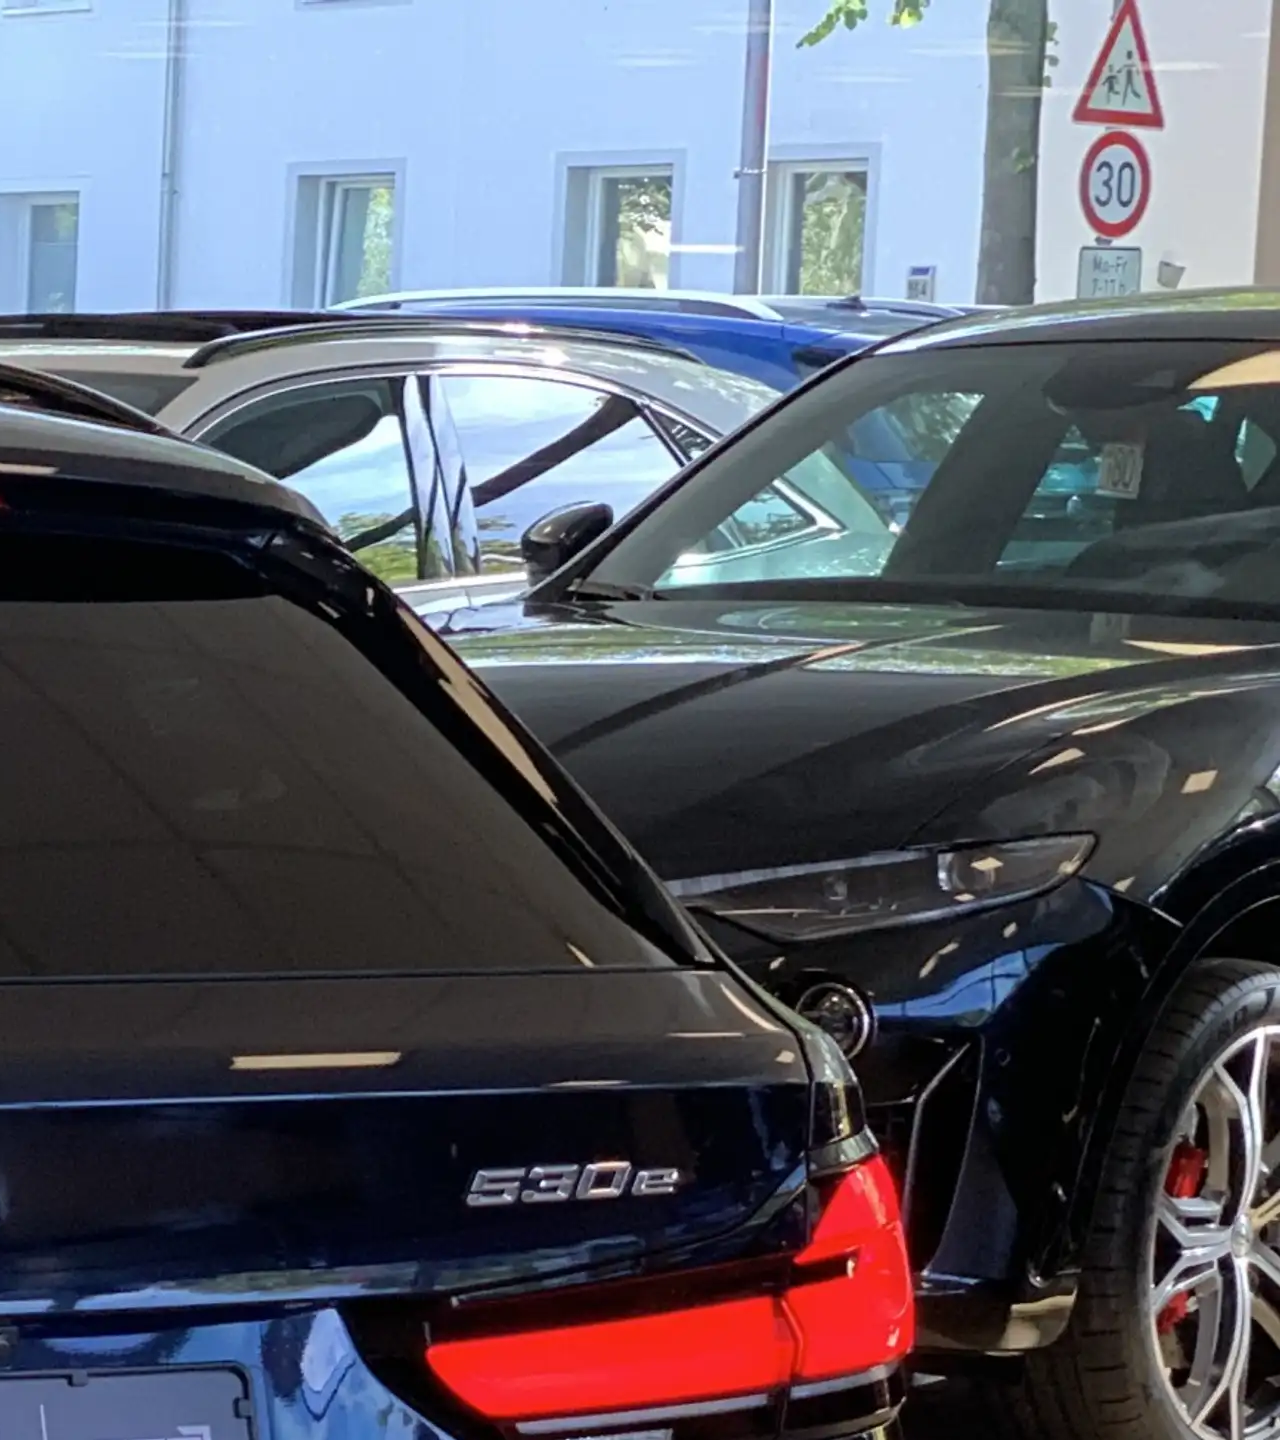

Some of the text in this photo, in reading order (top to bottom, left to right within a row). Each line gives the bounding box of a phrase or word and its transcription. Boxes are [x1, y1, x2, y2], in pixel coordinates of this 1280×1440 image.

[1094, 160, 1136, 208] 30
[1092, 255, 1128, 273] Mo-Fr
[466, 1160, 679, 1206] 530e
